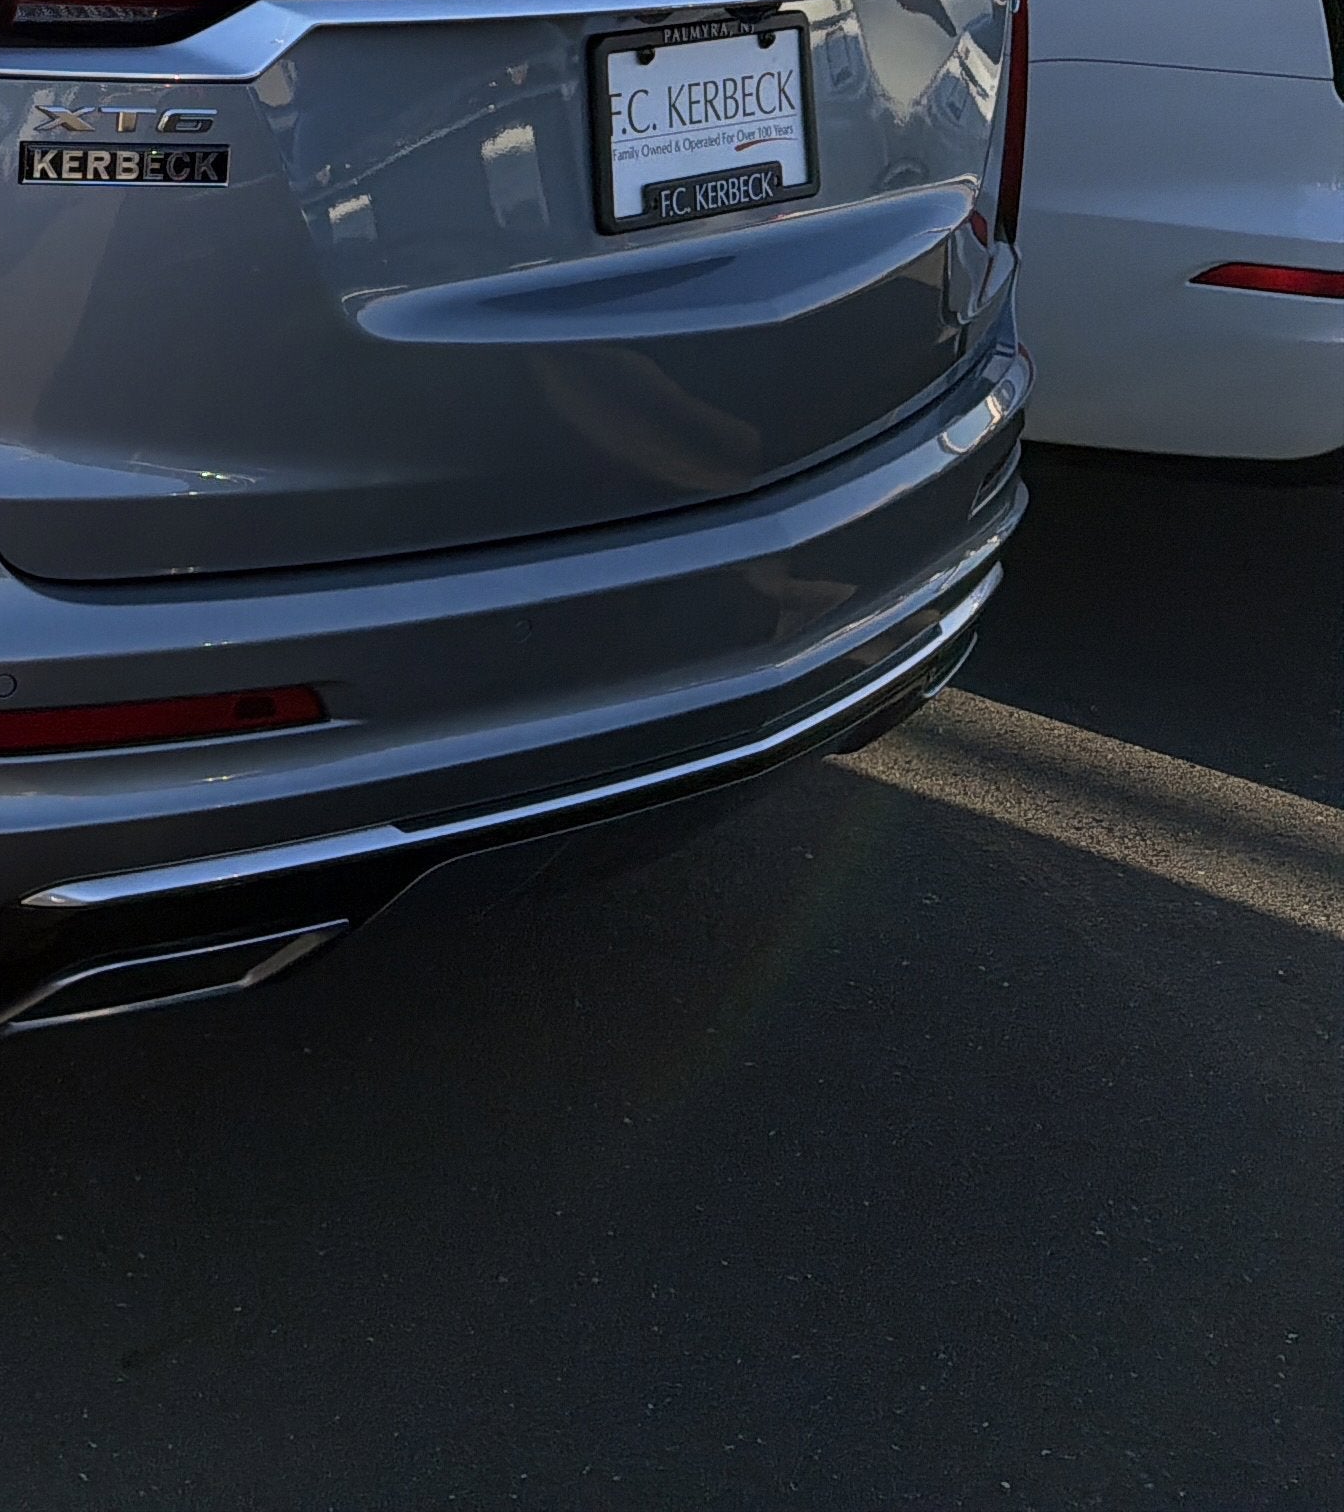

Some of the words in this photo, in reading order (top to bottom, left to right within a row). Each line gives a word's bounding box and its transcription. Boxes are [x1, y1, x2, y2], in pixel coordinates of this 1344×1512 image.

[664, 22, 733, 44] PALMYRA,
[34, 104, 218, 133] XT6
[610, 89, 657, 137] F.C.
[668, 69, 796, 129] KERBECK
[613, 146, 640, 162] Family
[641, 138, 672, 157] Owned
[674, 139, 681, 153] &
[682, 133, 721, 152] Operated
[722, 131, 735, 145] For
[737, 129, 756, 143] Over
[757, 126, 772, 139] 100
[773, 124, 794, 137] Years
[32, 149, 219, 181] KERBECK
[661, 188, 692, 218] F.C.
[696, 171, 774, 211] KERBECK
